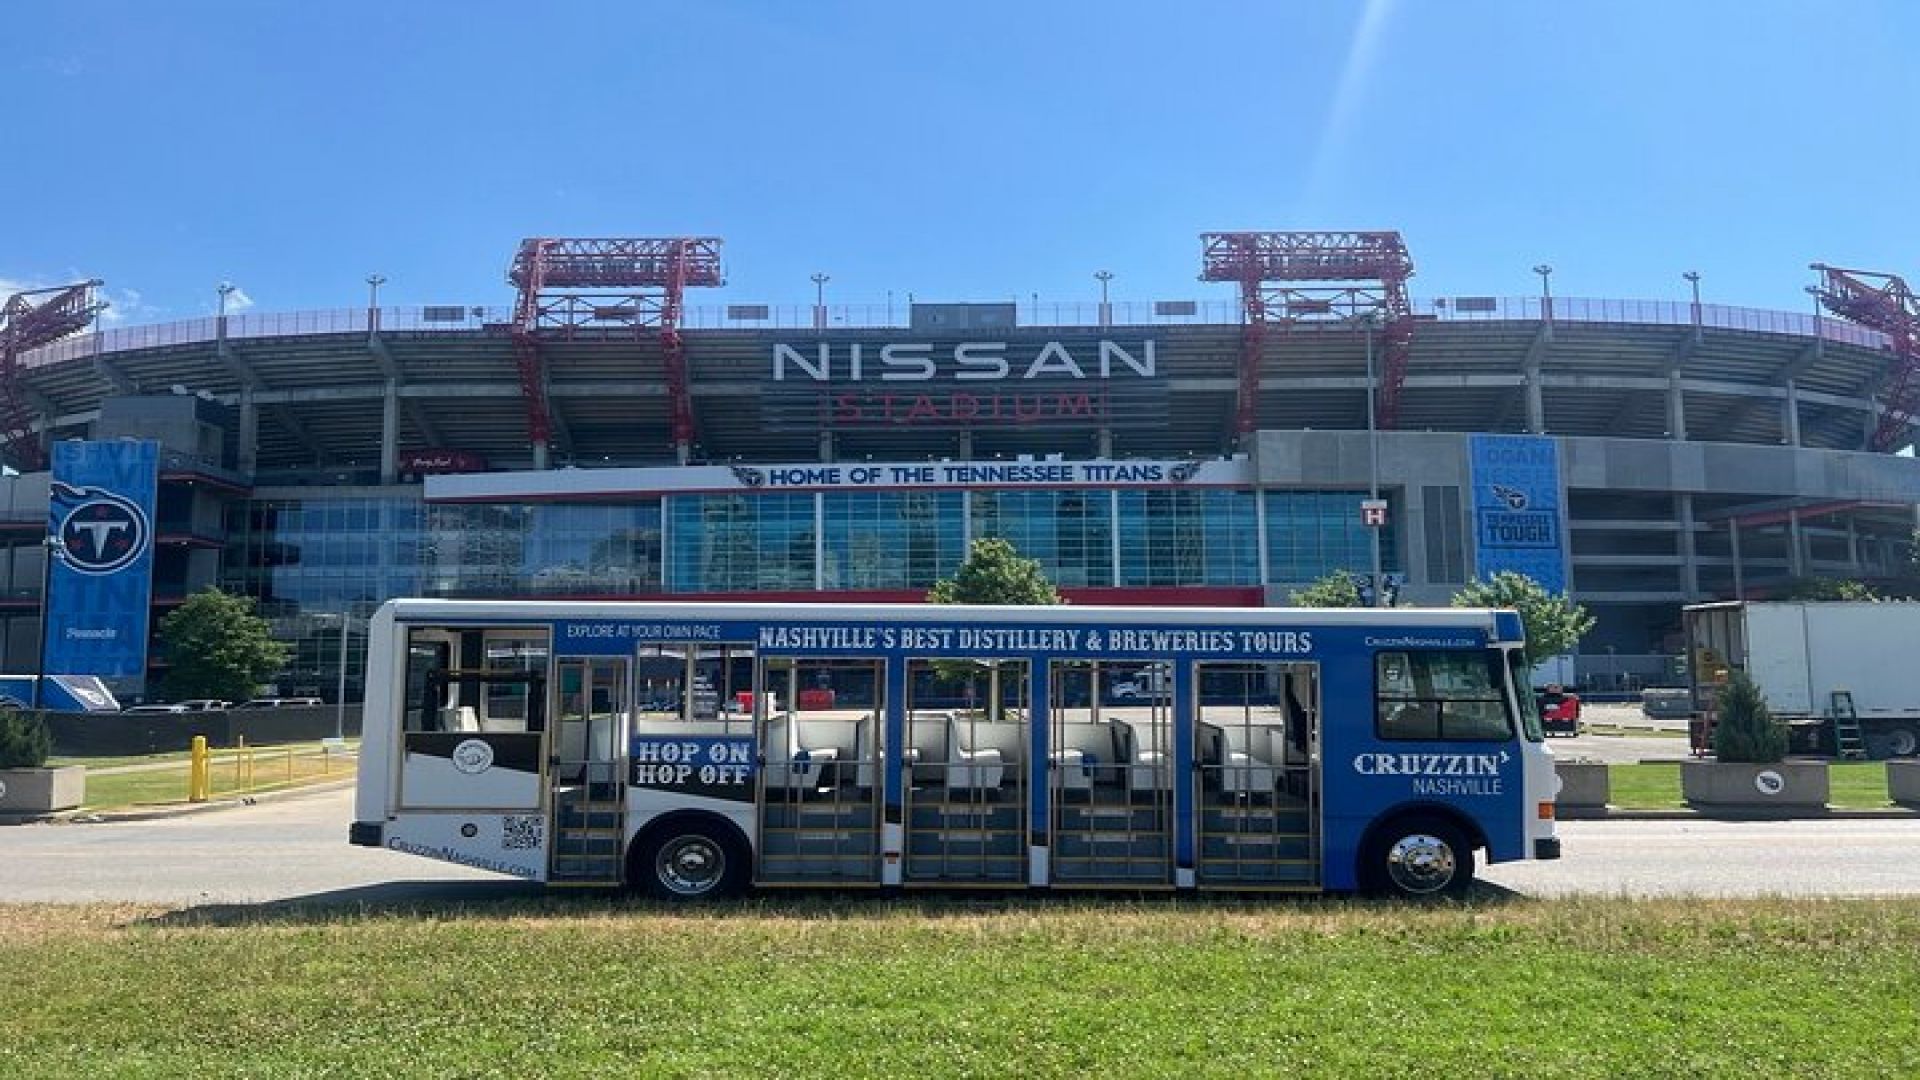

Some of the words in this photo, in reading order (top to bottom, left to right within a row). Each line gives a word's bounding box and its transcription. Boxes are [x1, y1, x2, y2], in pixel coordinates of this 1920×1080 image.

[773, 340, 1156, 381] NISSAN
[837, 391, 1092, 422] STADIUM
[770, 468, 840, 485] HOME
[850, 467, 881, 483] OF
[890, 467, 934, 483] THE
[943, 466, 1073, 483] TENNESSEE
[1082, 465, 1163, 481] TITANS
[1367, 510, 1384, 525] H
[1486, 526, 1552, 543] TOUGH
[567, 625, 614, 638] EXPLORE
[616, 625, 629, 638] AT
[631, 625, 662, 638] YOUR
[664, 625, 691, 638] OWN
[693, 625, 721, 638] PACE
[759, 627, 896, 648] NASHVILLE'S
[901, 629, 952, 649] BEST
[959, 629, 1081, 650] DISTILLERY
[1086, 630, 1102, 650] &
[1109, 630, 1235, 651] BREWERIES
[1239, 631, 1312, 653] TOURS
[639, 742, 700, 762] HOP
[709, 743, 750, 763] ON
[1353, 751, 1510, 775] CRUZZIN'
[637, 765, 692, 784] HOP
[700, 765, 750, 785] OFF
[1412, 778, 1502, 795] NASHVILLE
